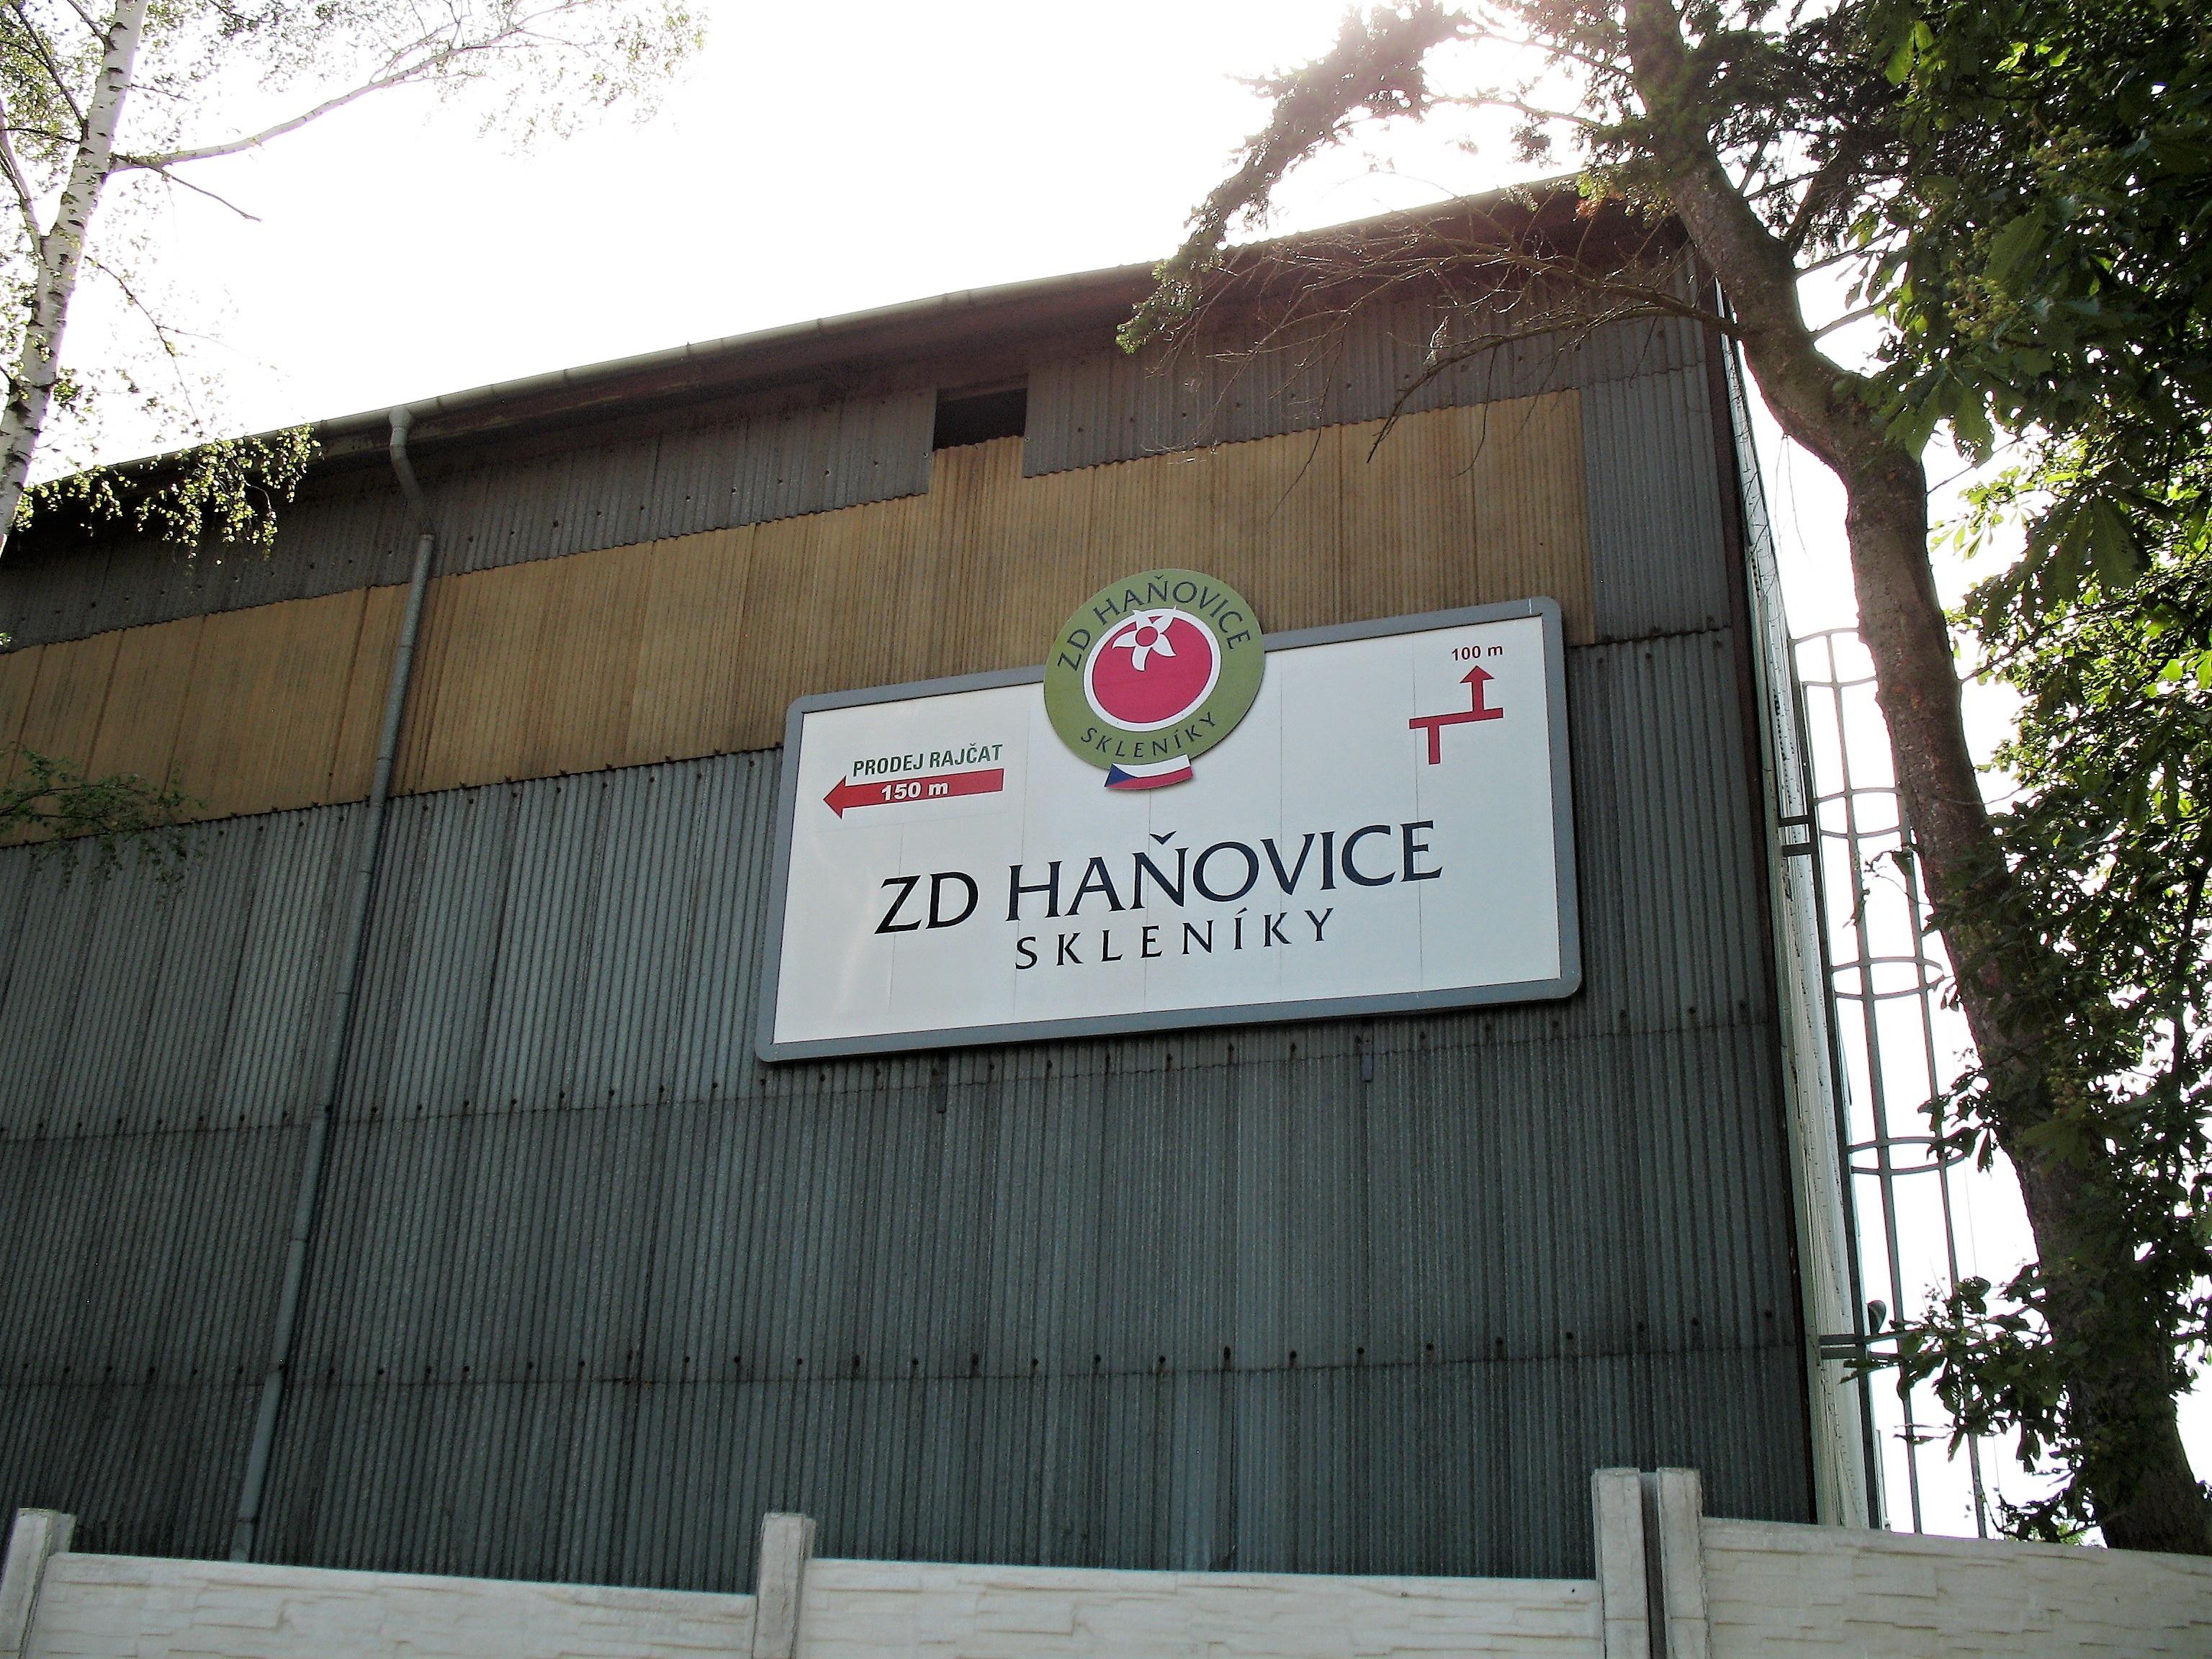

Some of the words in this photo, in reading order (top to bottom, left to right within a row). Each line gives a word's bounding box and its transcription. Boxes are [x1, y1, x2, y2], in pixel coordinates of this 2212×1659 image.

[1057, 628, 1092, 671] ZD
[1092, 575, 1251, 649] HAŇOVICE
[1452, 646, 1481, 661] 100
[1488, 645, 1503, 657] m
[1081, 712, 1216, 757] SKLENÍKY
[853, 753, 924, 777] PRODEJ
[930, 742, 1004, 768] RAJČAT
[881, 781, 922, 801] 150
[928, 782, 949, 796] m
[874, 871, 979, 935] ZD
[1005, 819, 1443, 922] HAŇOVICE
[1015, 907, 1334, 970] SKLENÍKY
